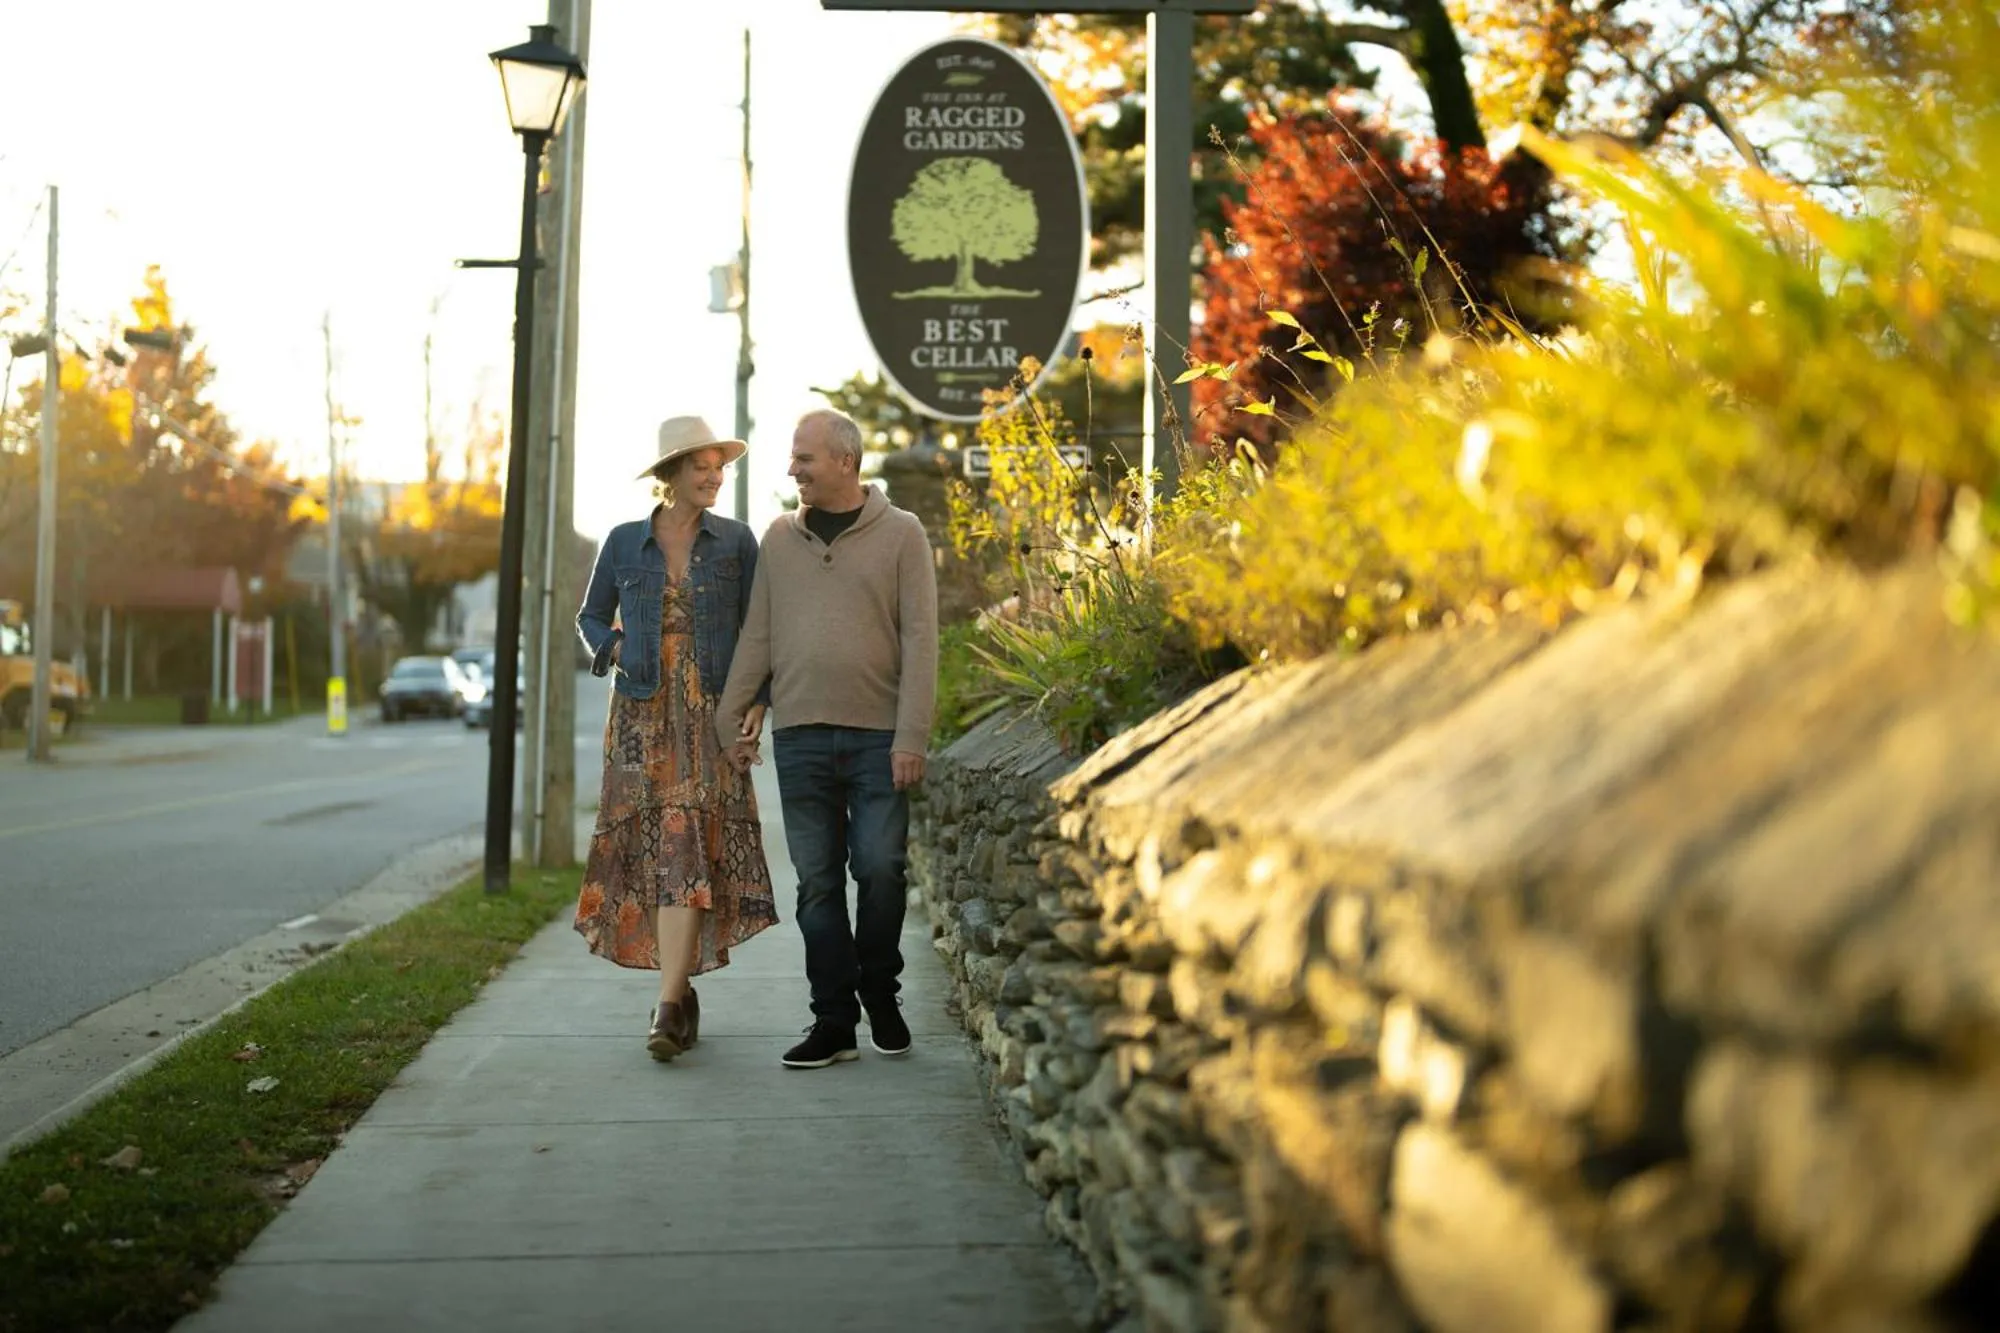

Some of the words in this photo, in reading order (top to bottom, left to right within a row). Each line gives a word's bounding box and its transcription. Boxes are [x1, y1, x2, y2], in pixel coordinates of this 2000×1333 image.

[904, 106, 1026, 128] RAGGED
[903, 130, 1025, 150] GARDENS
[949, 304, 981, 316] THE
[923, 318, 1010, 344] BEST
[910, 345, 1019, 369] CELLAR
